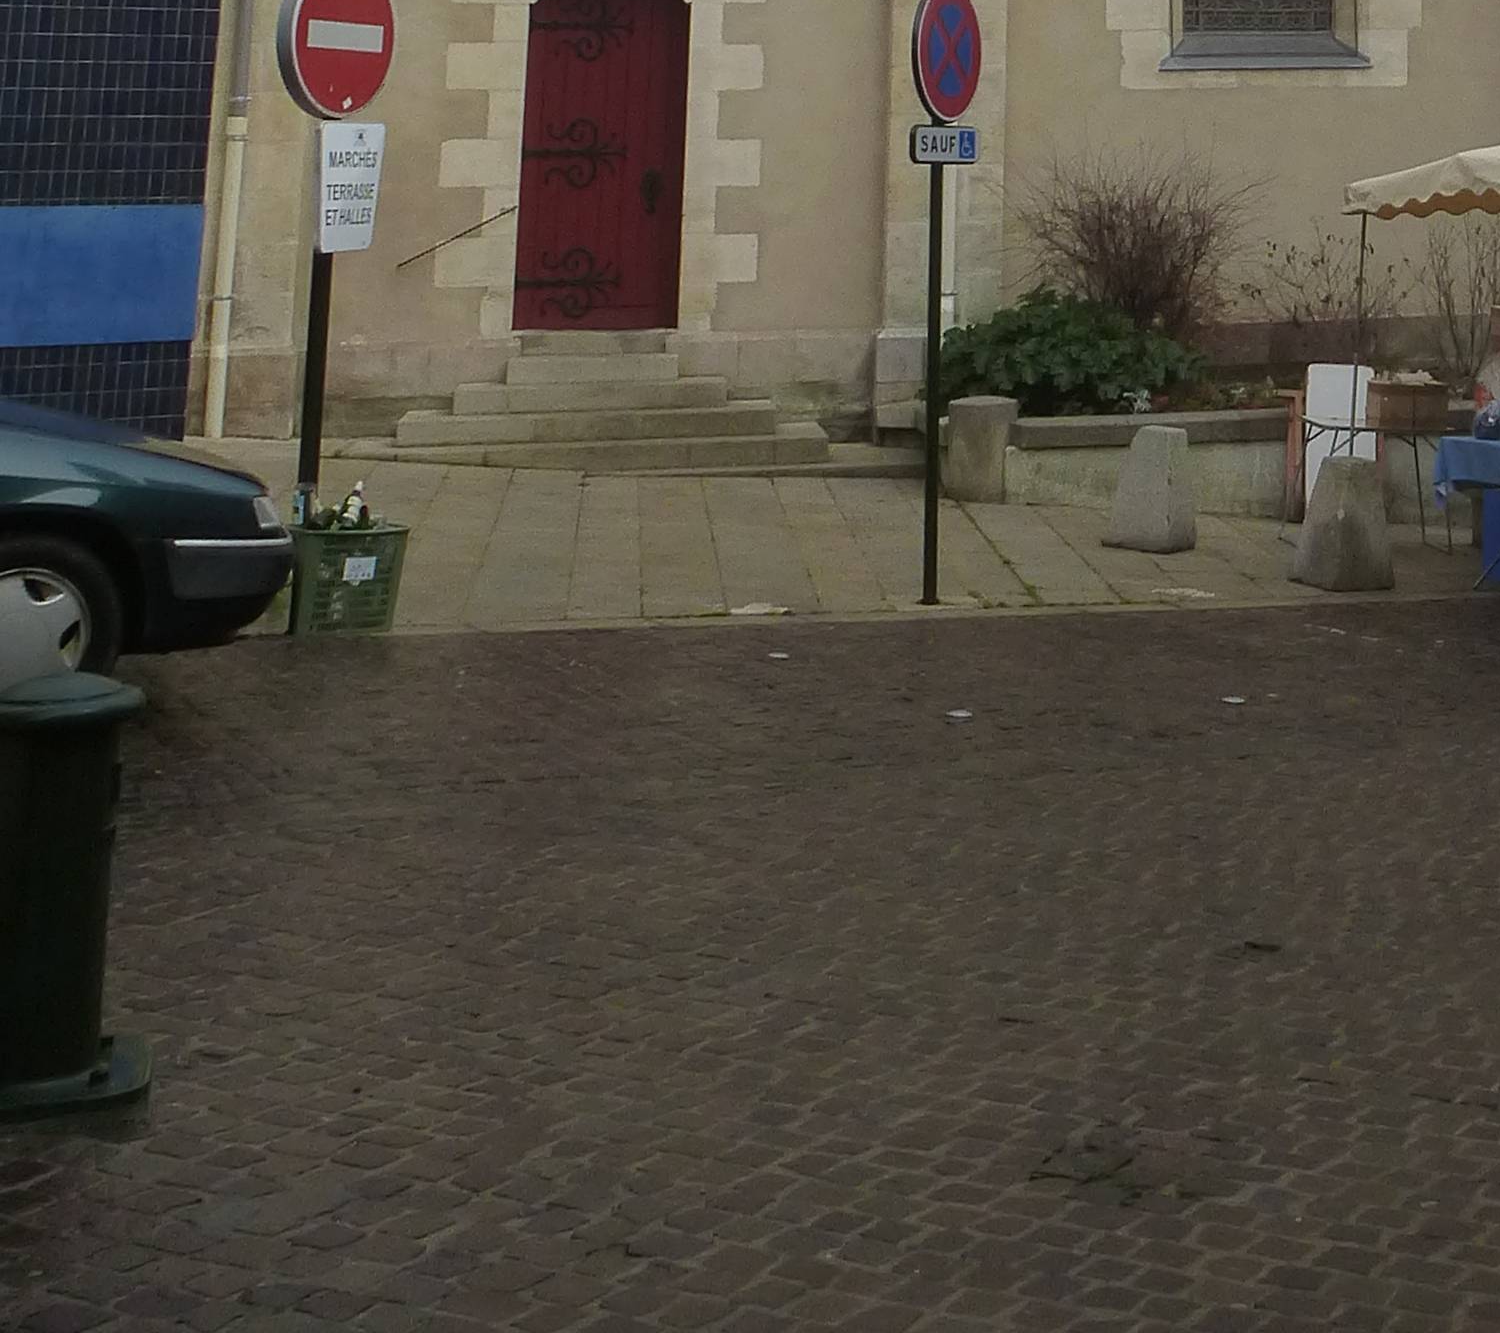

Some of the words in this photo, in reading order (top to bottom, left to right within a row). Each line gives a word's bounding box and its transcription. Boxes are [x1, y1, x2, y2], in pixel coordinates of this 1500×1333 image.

[921, 135, 956, 153] SAUF
[326, 183, 375, 201] TERRASSE
[325, 209, 338, 226] ET
[338, 207, 372, 225] HALLES
